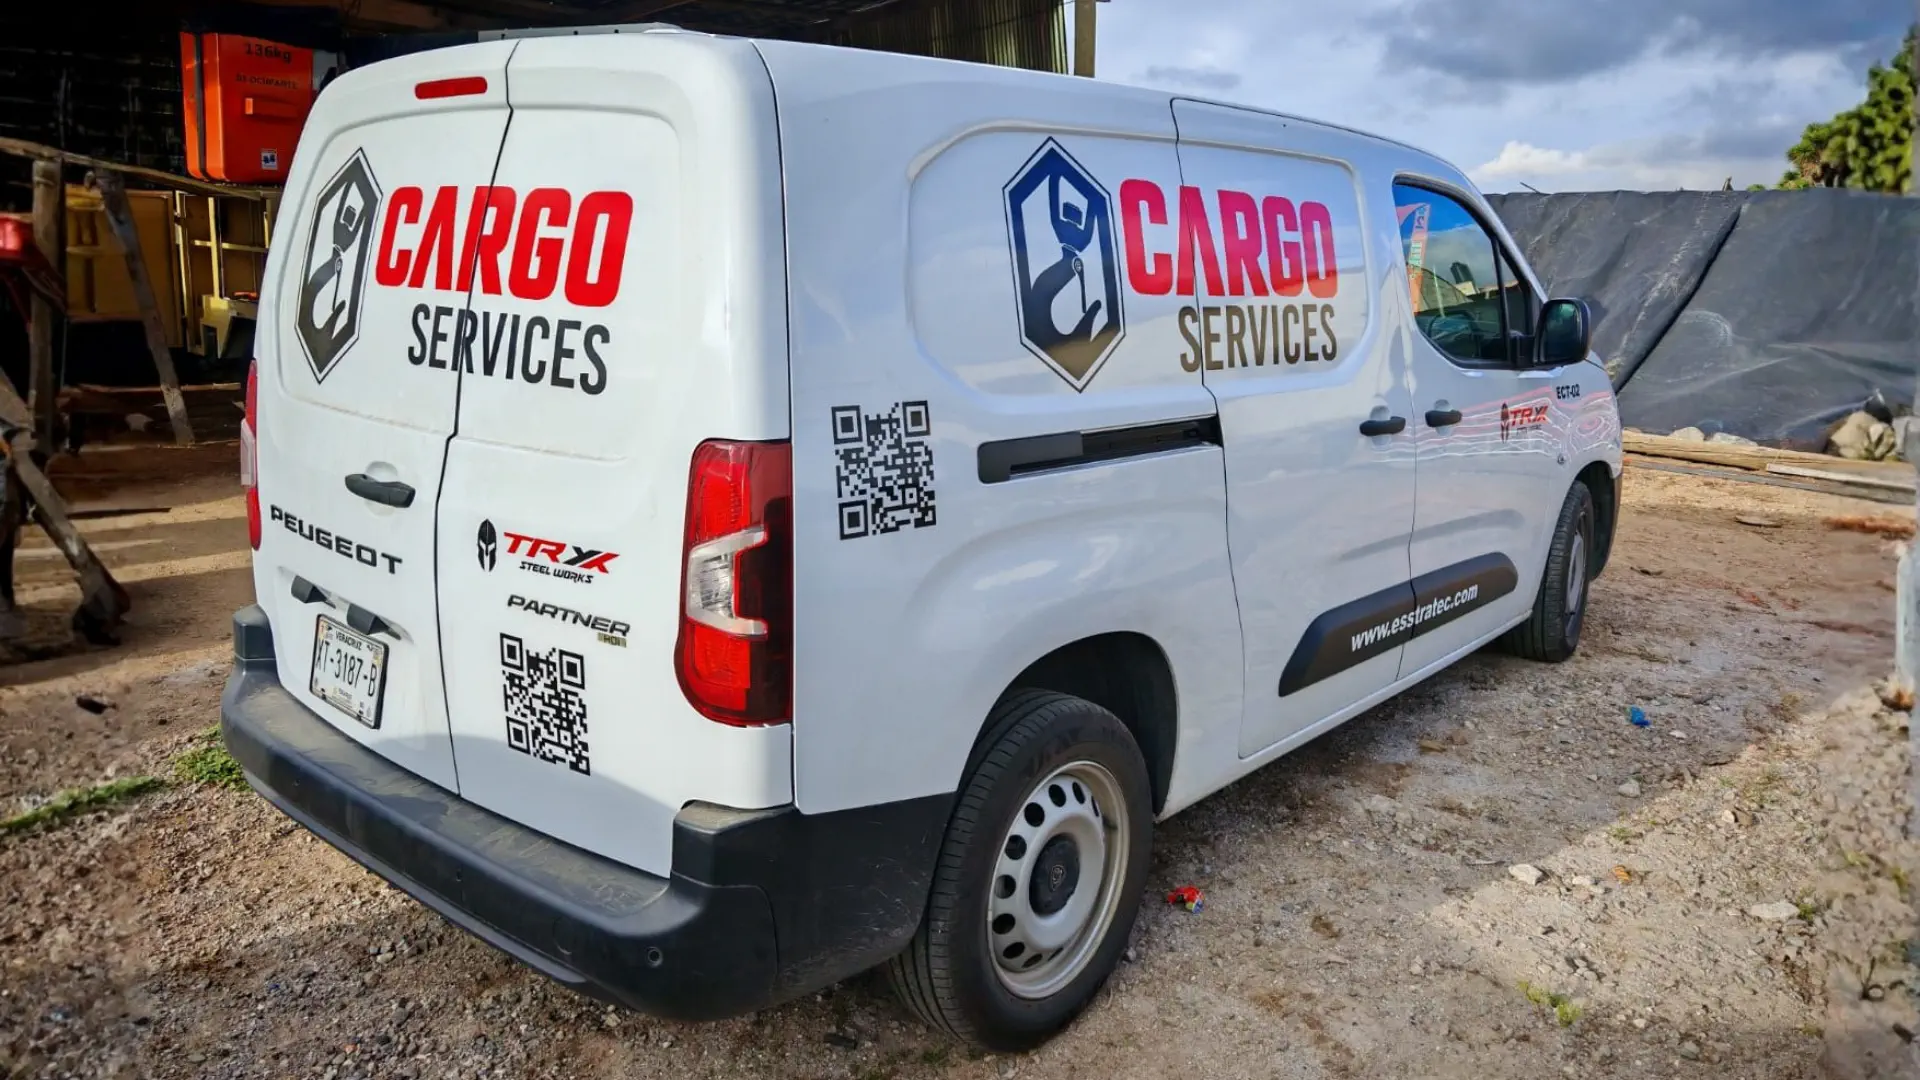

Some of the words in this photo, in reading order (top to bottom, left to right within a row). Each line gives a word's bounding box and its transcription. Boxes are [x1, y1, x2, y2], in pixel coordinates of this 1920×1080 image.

[244, 43, 293, 63] 136kg
[375, 185, 634, 307] CARGO
[1119, 178, 1339, 298] CARGO
[407, 303, 611, 395] SERVICES
[1178, 304, 1338, 373] SERVICES
[1556, 384, 1581, 399] ECT-02
[270, 504, 403, 575] PEUGEOT
[519, 560, 551, 576] STEEL
[553, 568, 594, 584] WORKS
[335, 630, 362, 651] VERACRUZ
[507, 594, 631, 637] PARTNER
[1350, 583, 1479, 653] www.esstratec.com
